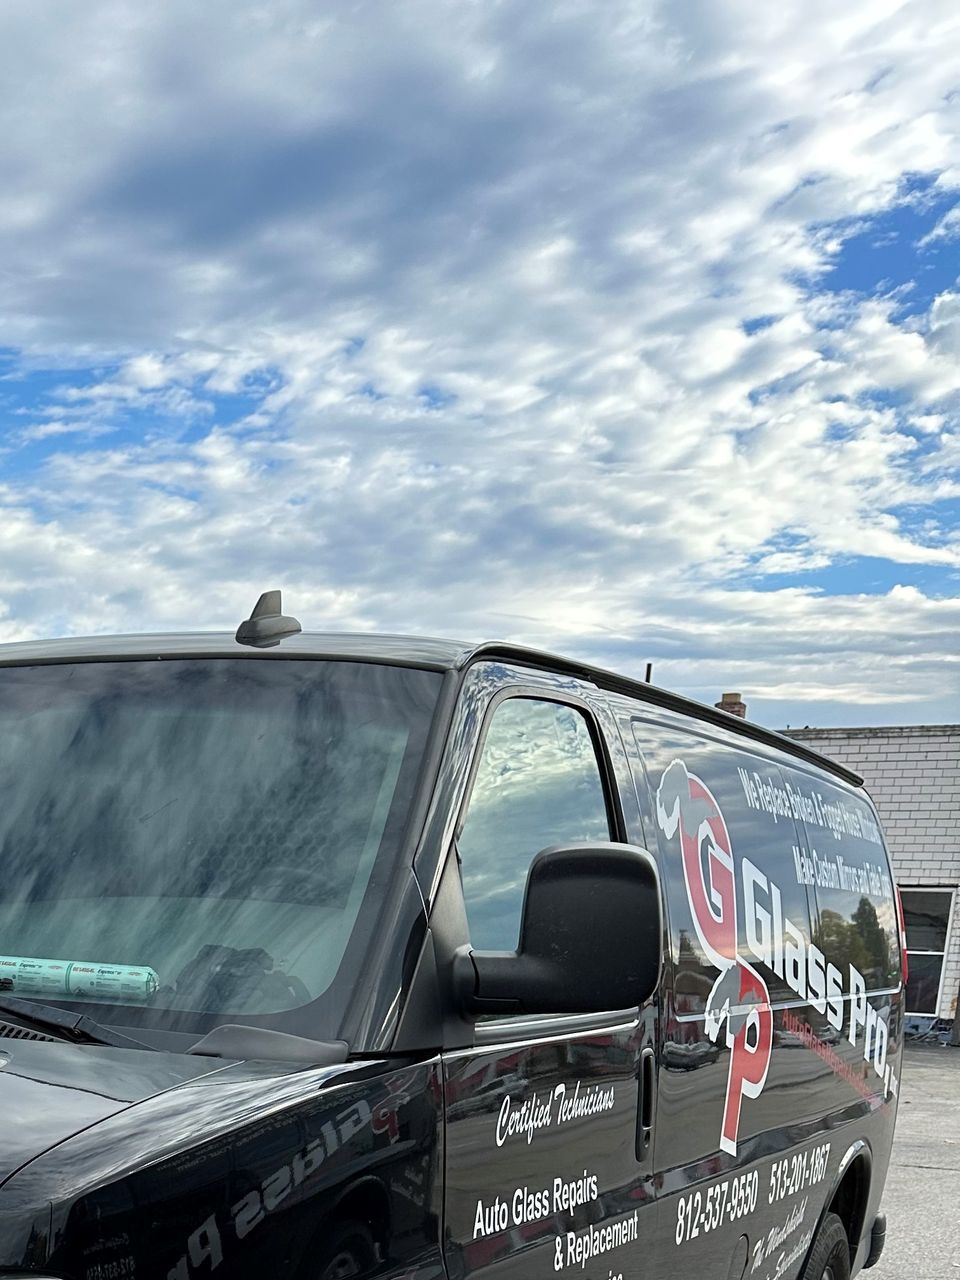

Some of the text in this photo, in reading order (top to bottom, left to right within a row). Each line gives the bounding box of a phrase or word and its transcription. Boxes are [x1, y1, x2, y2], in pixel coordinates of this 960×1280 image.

[737, 767, 760, 810] We
[753, 771, 793, 824] Replace
[792, 845, 815, 886] Make
[742, 857, 844, 1032] Glass
[495, 1081, 615, 1147] Certified Technicians
[473, 1169, 598, 1239] Auto Glass Repairs
[675, 1143, 831, 1246] 812-537-9550 513-201-1867
[554, 1210, 639, 1271] & Replacement
